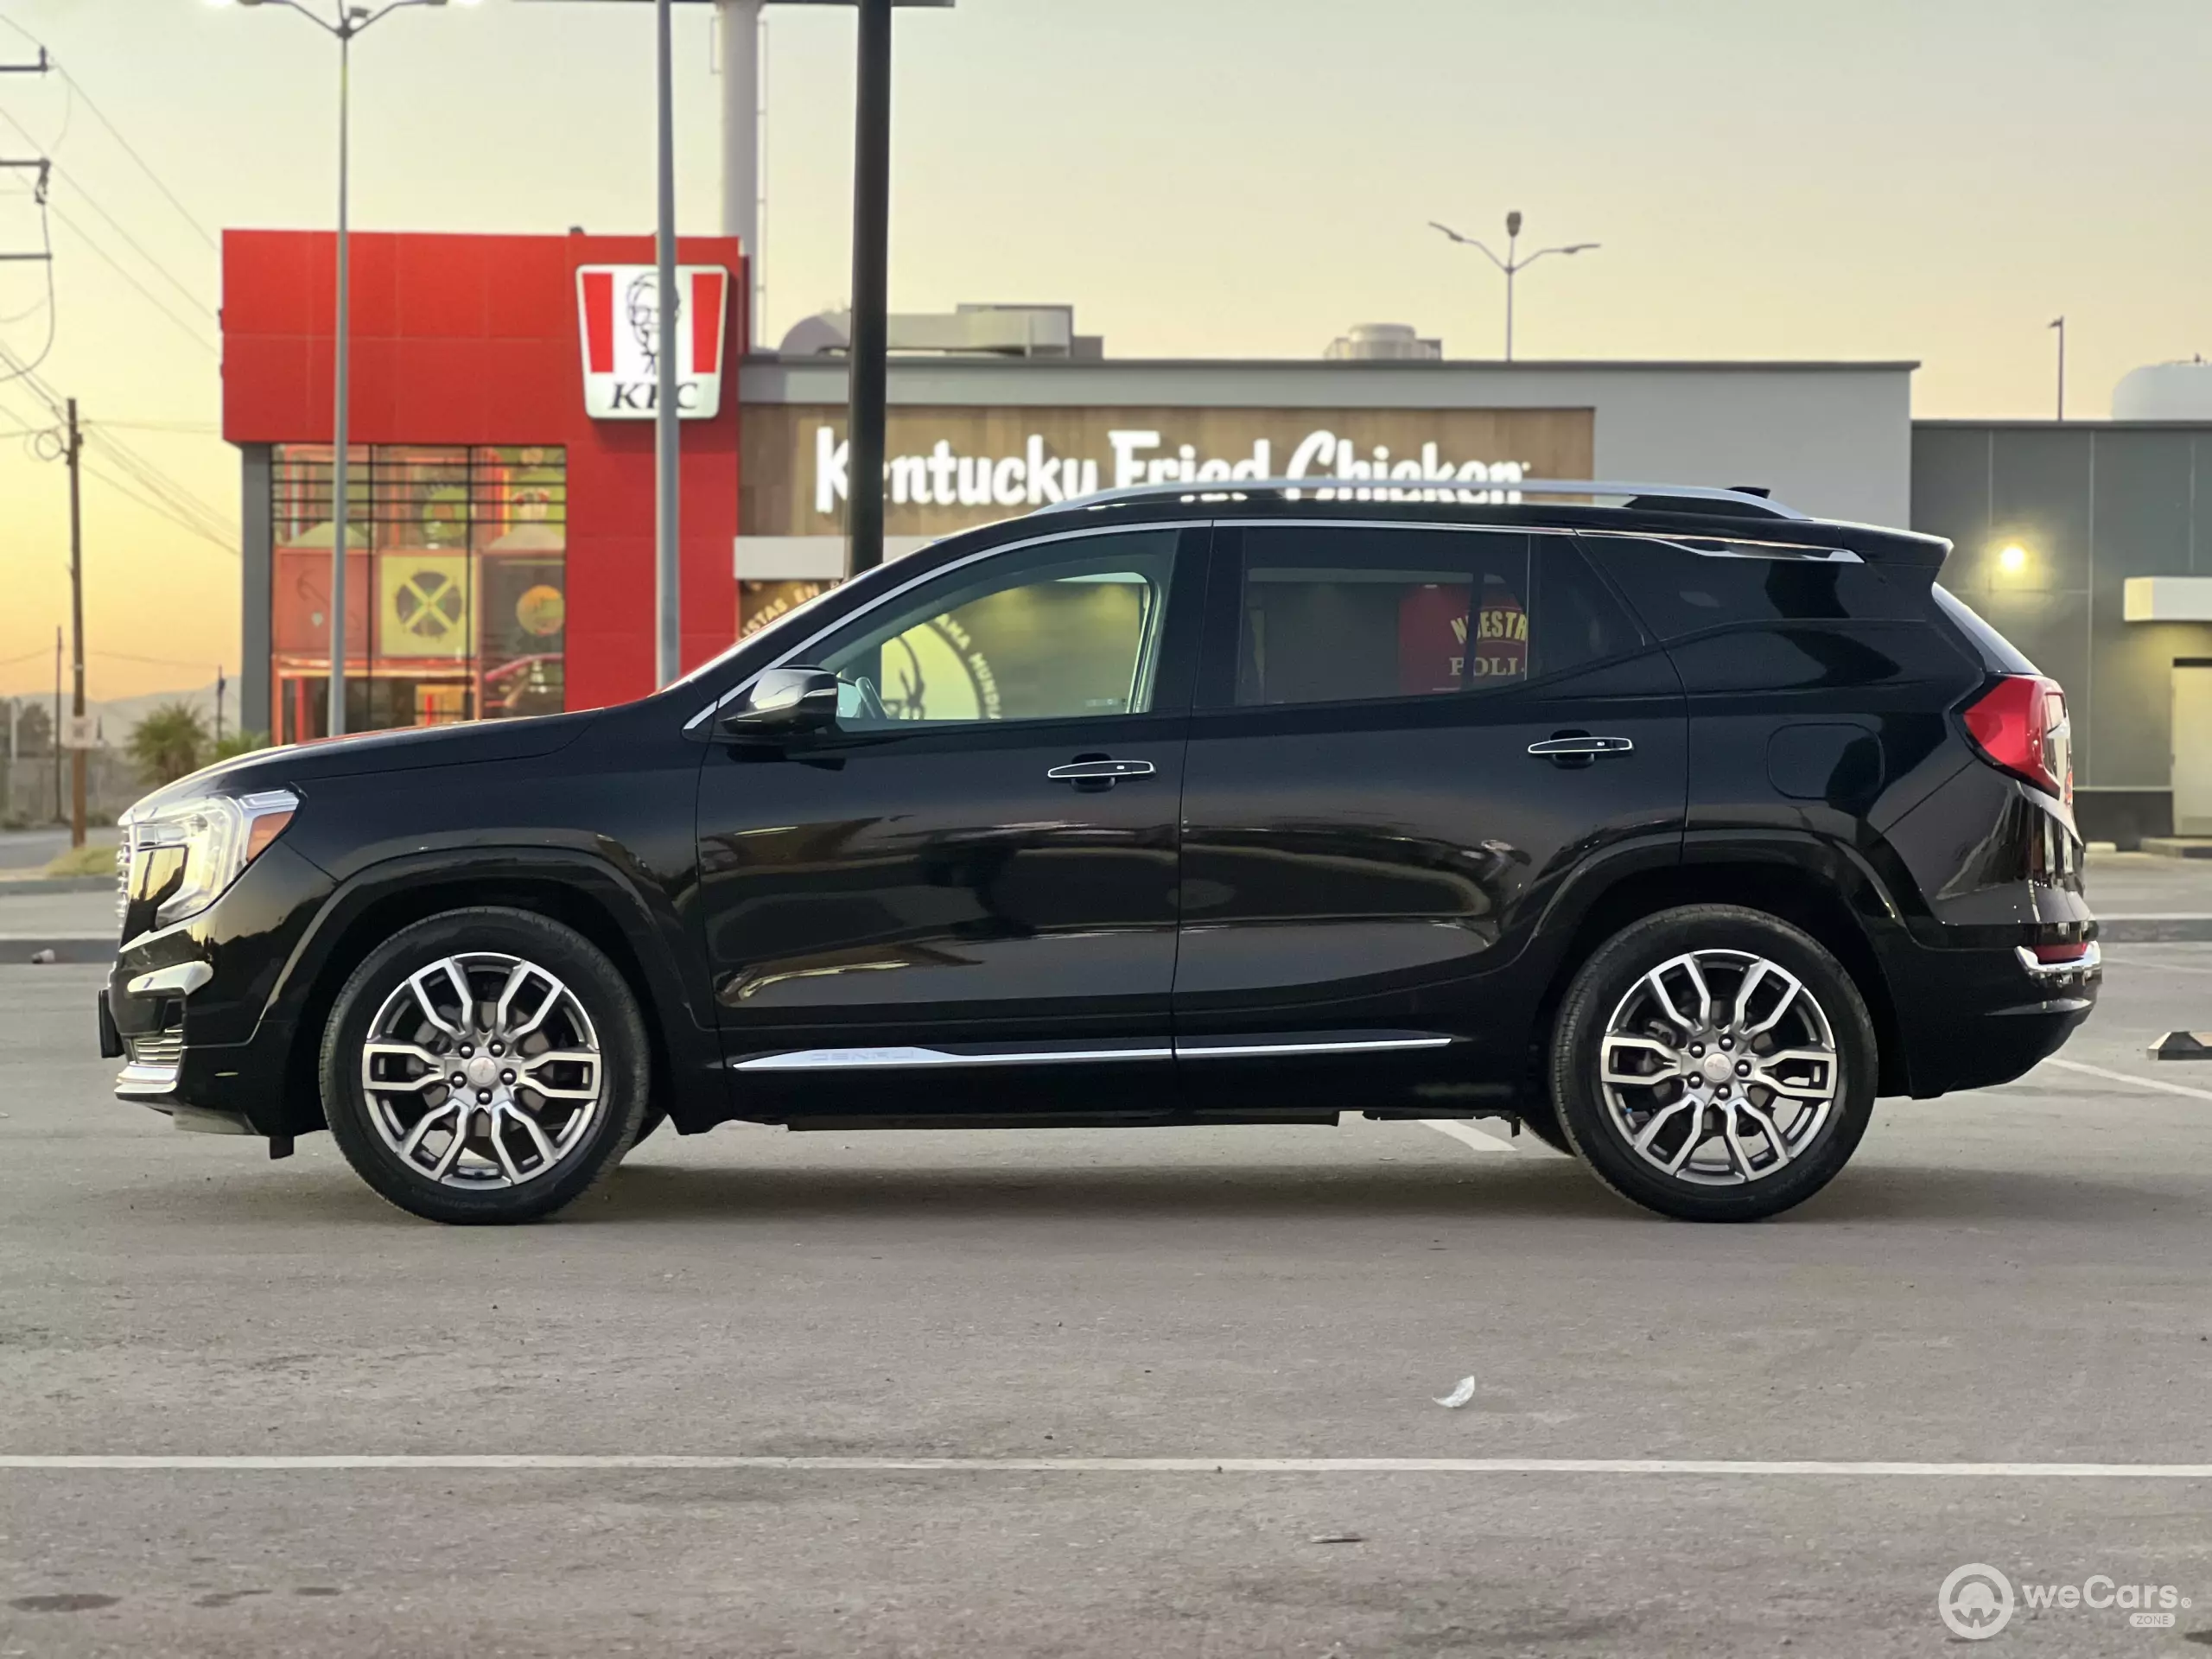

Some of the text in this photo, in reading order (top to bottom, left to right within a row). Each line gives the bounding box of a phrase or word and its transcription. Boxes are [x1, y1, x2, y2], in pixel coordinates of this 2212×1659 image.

[816, 426, 1522, 513] Kntucky Fried Chicken
